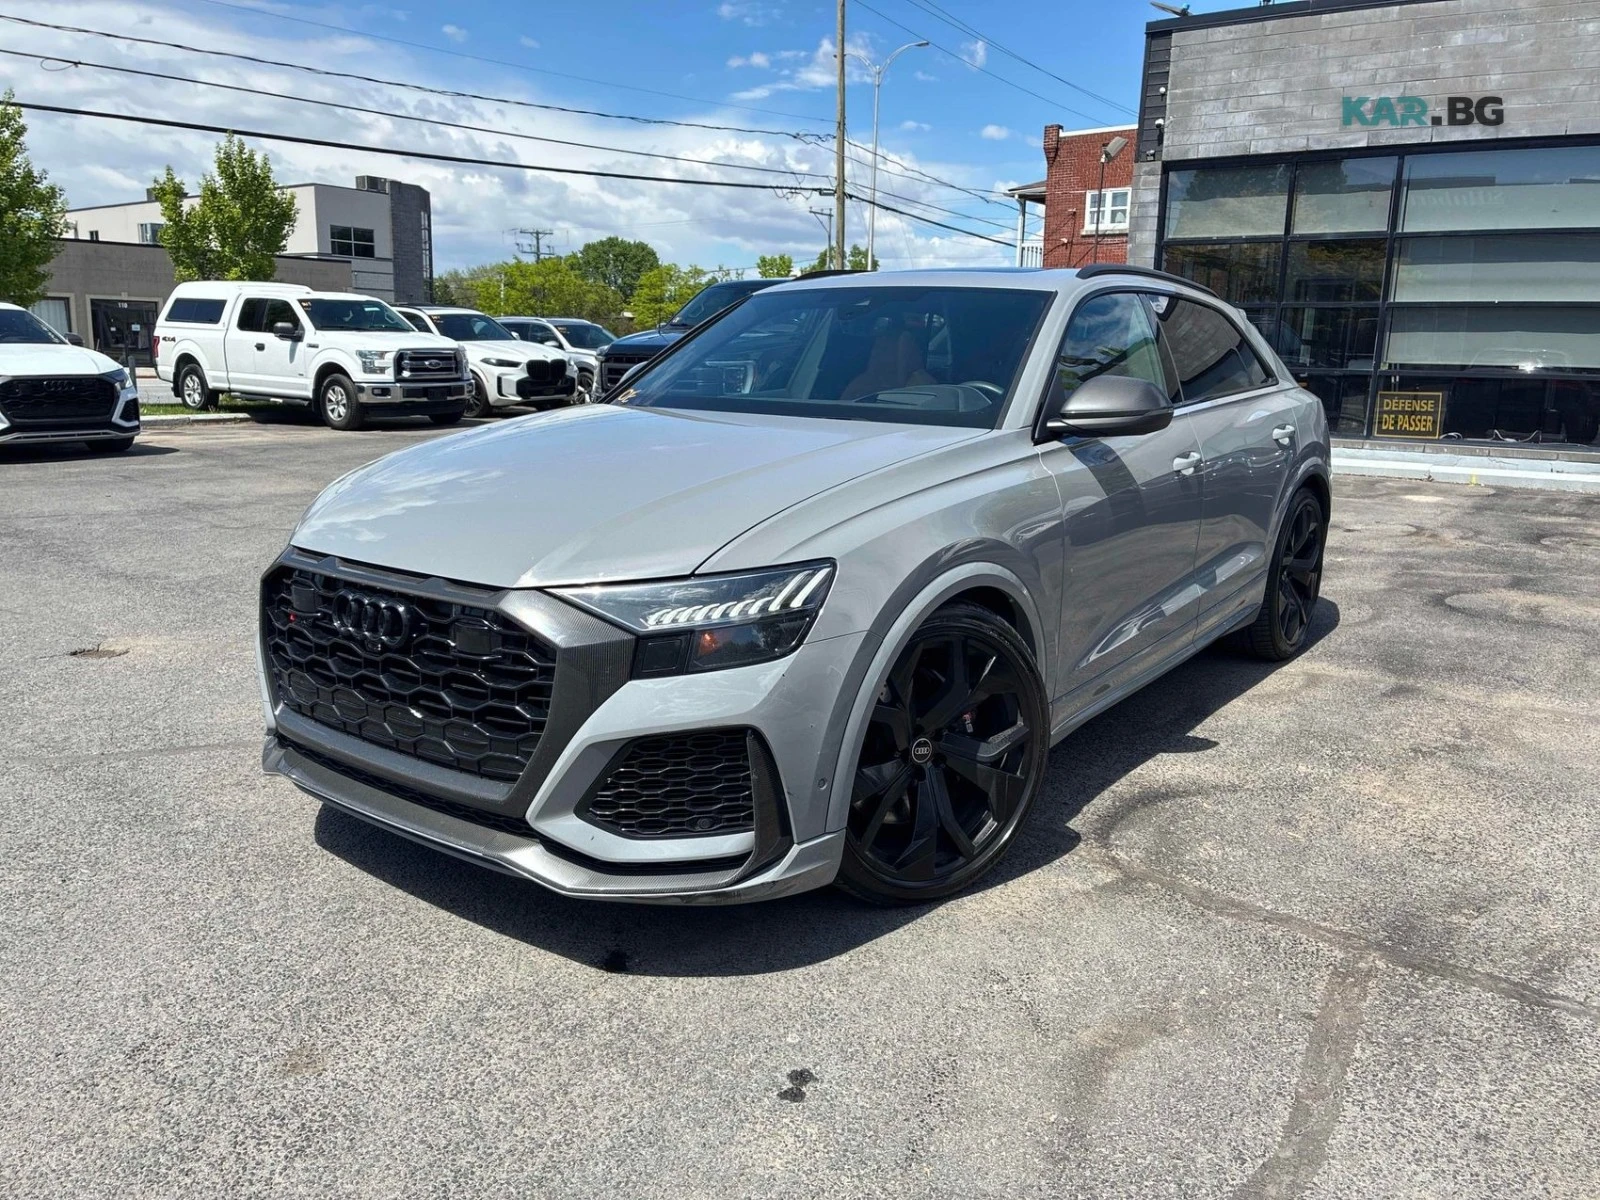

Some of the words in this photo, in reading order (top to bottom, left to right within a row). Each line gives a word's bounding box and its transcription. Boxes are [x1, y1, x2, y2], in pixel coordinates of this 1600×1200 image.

[1383, 397, 1434, 411] DÉFENSE
[1382, 414, 1394, 430] DE
[1397, 415, 1433, 431] PASSER
